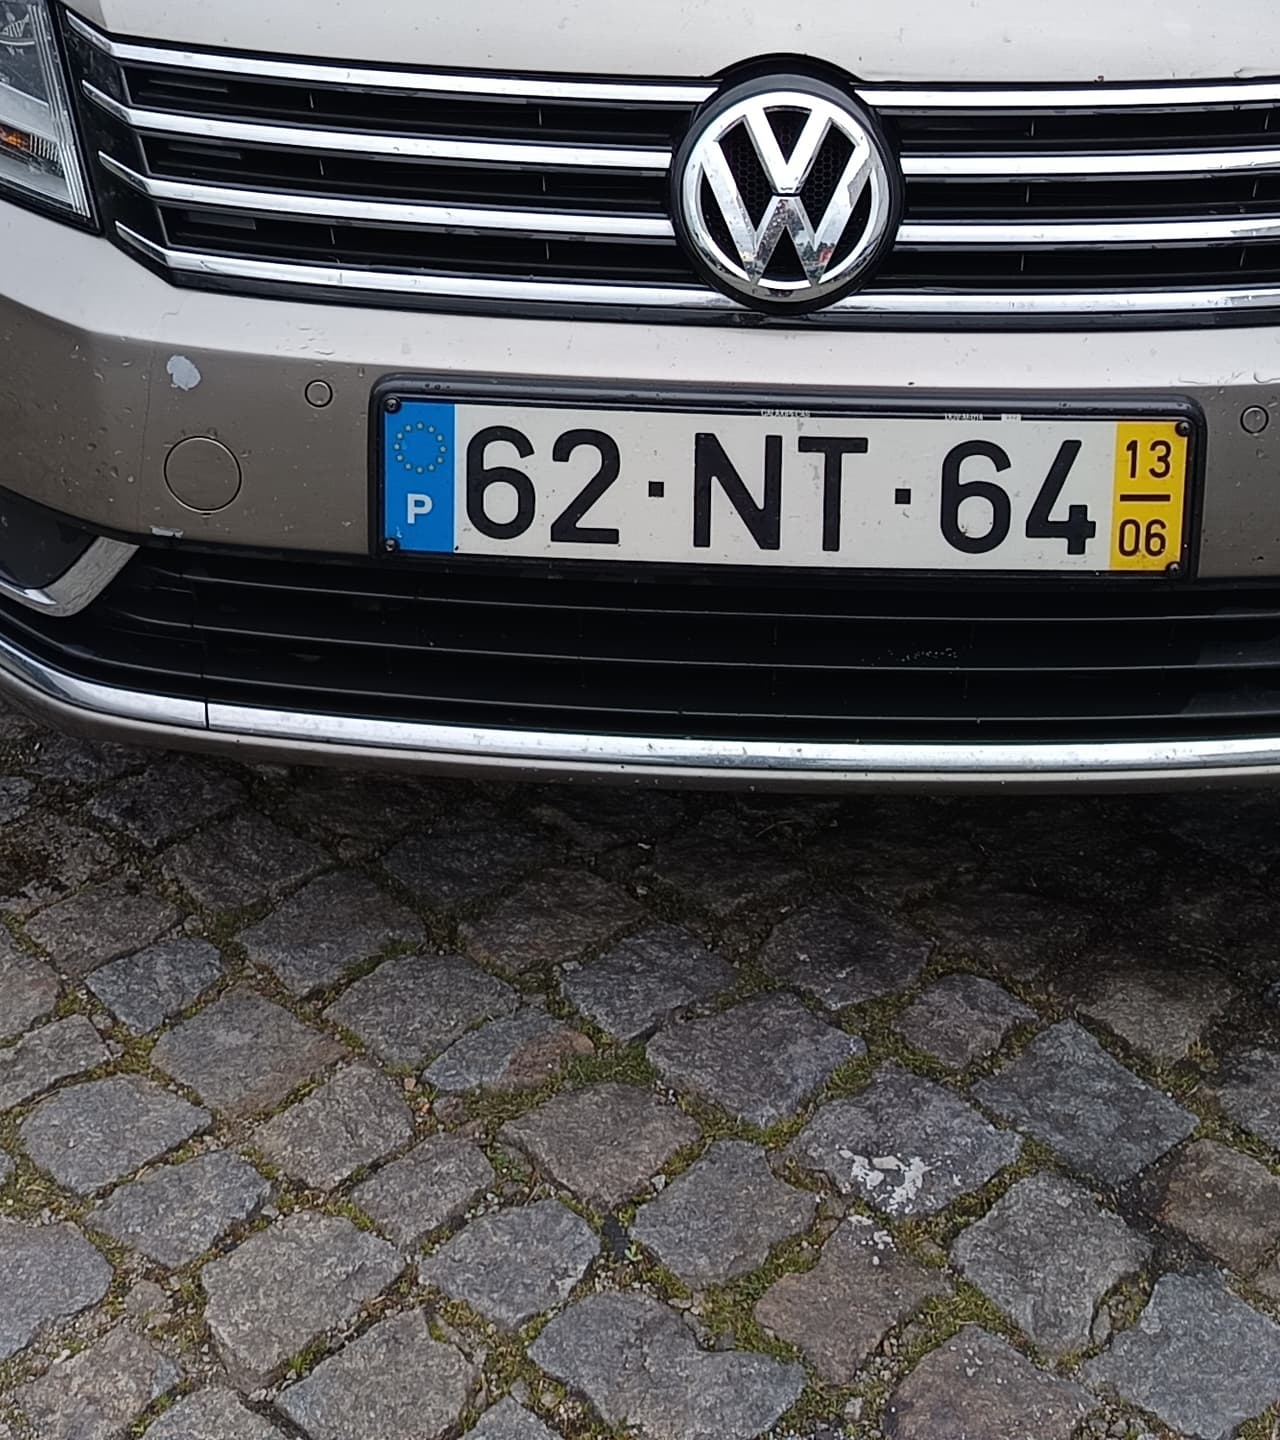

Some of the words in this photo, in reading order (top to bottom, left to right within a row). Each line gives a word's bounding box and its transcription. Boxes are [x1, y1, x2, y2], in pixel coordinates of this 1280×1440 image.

[1125, 439, 1172, 479] 13
[406, 492, 434, 525] P
[1118, 518, 1167, 557] 06
